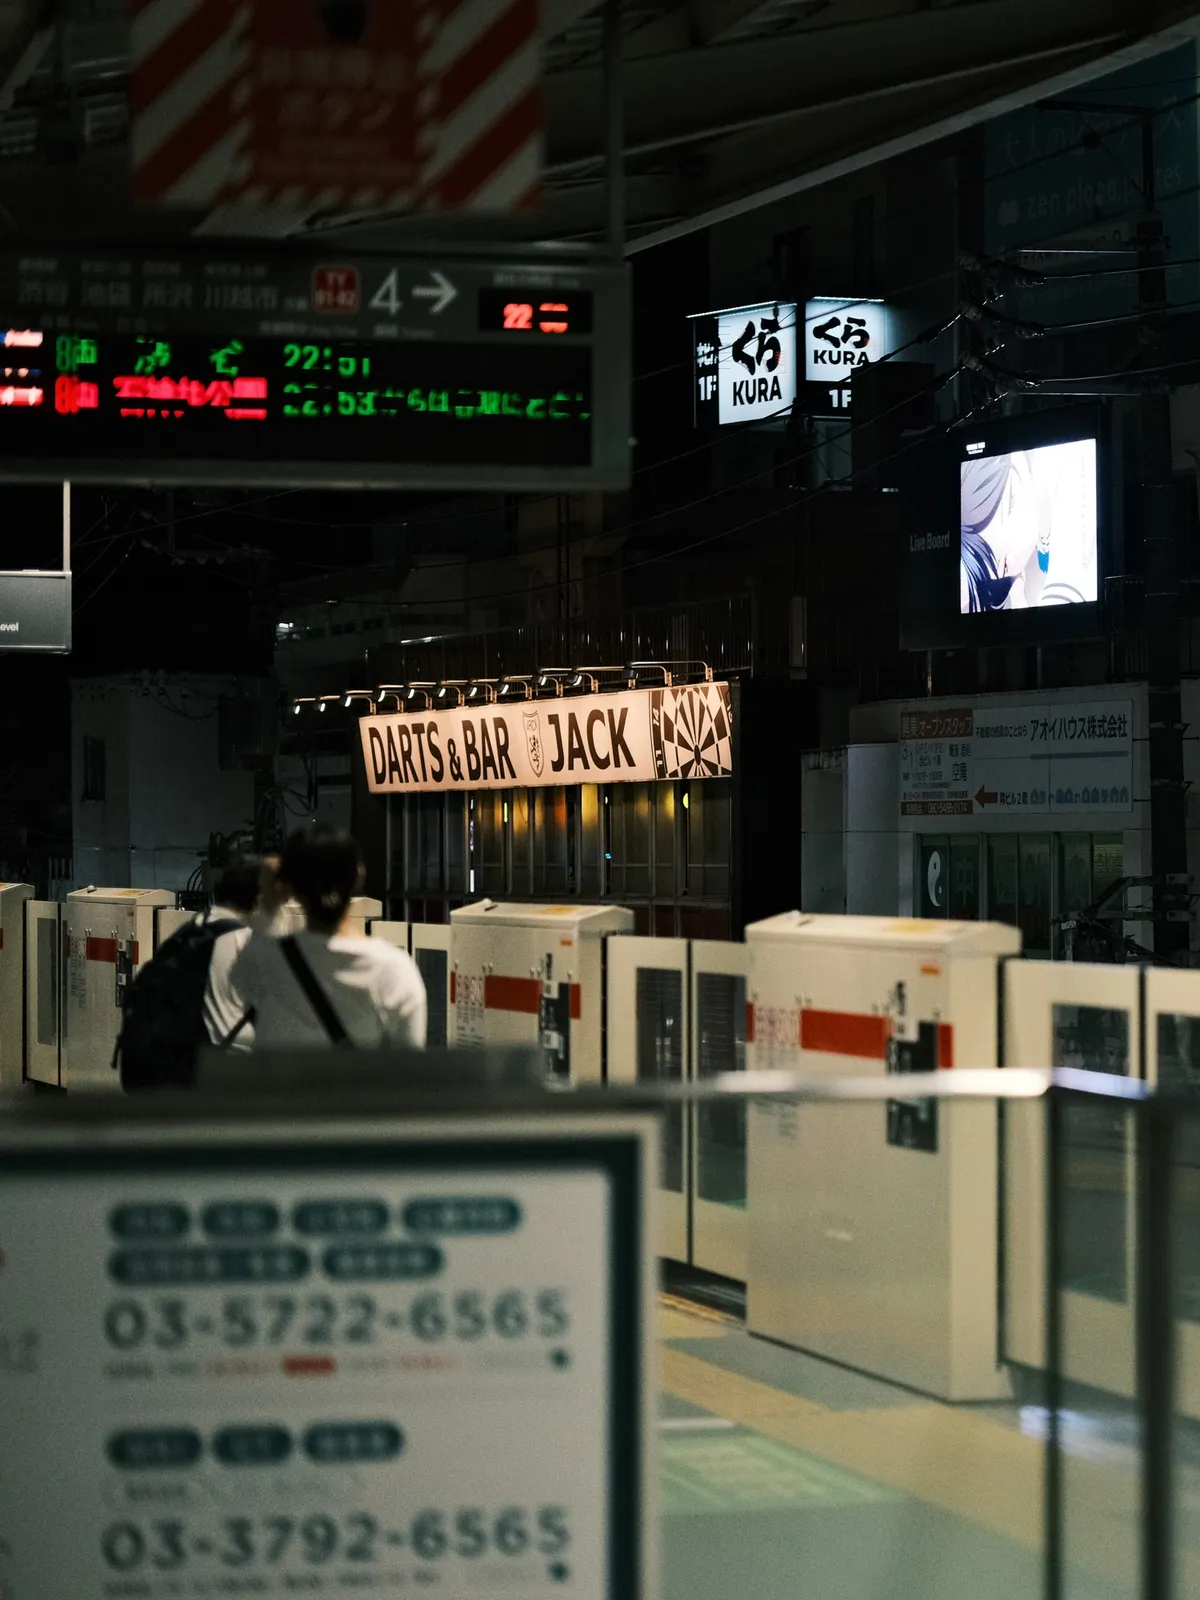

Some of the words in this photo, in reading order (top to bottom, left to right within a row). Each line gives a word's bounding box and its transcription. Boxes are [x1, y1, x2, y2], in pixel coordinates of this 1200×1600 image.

[370, 267, 403, 315] 4
[732, 318, 781, 376] くら
[812, 316, 870, 349] くら
[813, 350, 870, 366] KURA
[733, 376, 782, 407] KURA
[910, 533, 926, 552] Live
[926, 529, 950, 549] Board
[0, 622, 19, 632] evel
[1030, 713, 1128, 742] アオイハウス株式会社
[369, 721, 444, 785] DARTS
[447, 738, 463, 782] &
[462, 716, 517, 781] BAR
[548, 707, 636, 773] JACK
[105, 1291, 570, 1350] 03-5722-6565
[101, 1506, 571, 1571] 03-3792-6565
